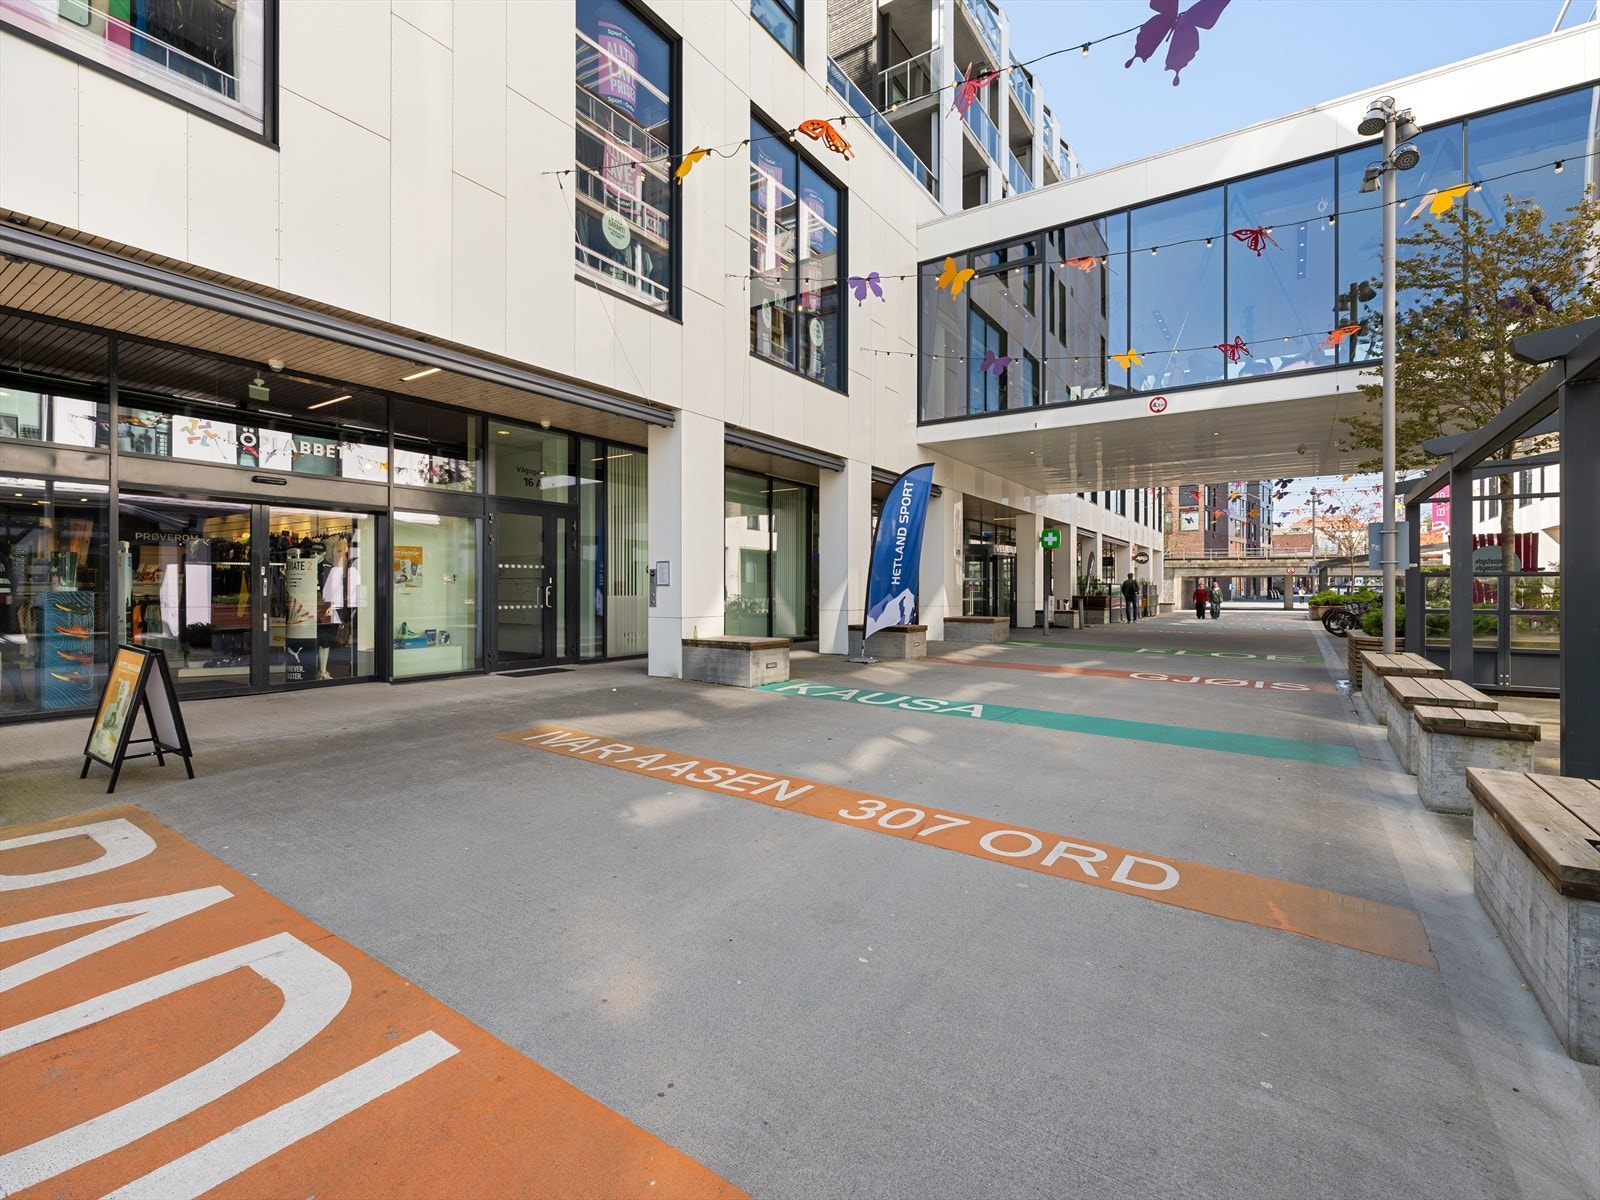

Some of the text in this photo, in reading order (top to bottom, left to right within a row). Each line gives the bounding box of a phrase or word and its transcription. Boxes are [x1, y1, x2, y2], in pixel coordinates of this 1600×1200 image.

[227, 427, 345, 460] LÖPLABBET
[523, 477, 534, 488] 16
[135, 532, 199, 543] PRØVEROM
[890, 480, 914, 586] HETLAND SPORT
[1129, 672, 1311, 691] GJØIS
[775, 683, 984, 718] KAUSA
[522, 730, 1181, 892] IVAR AASEN 307 ORD
